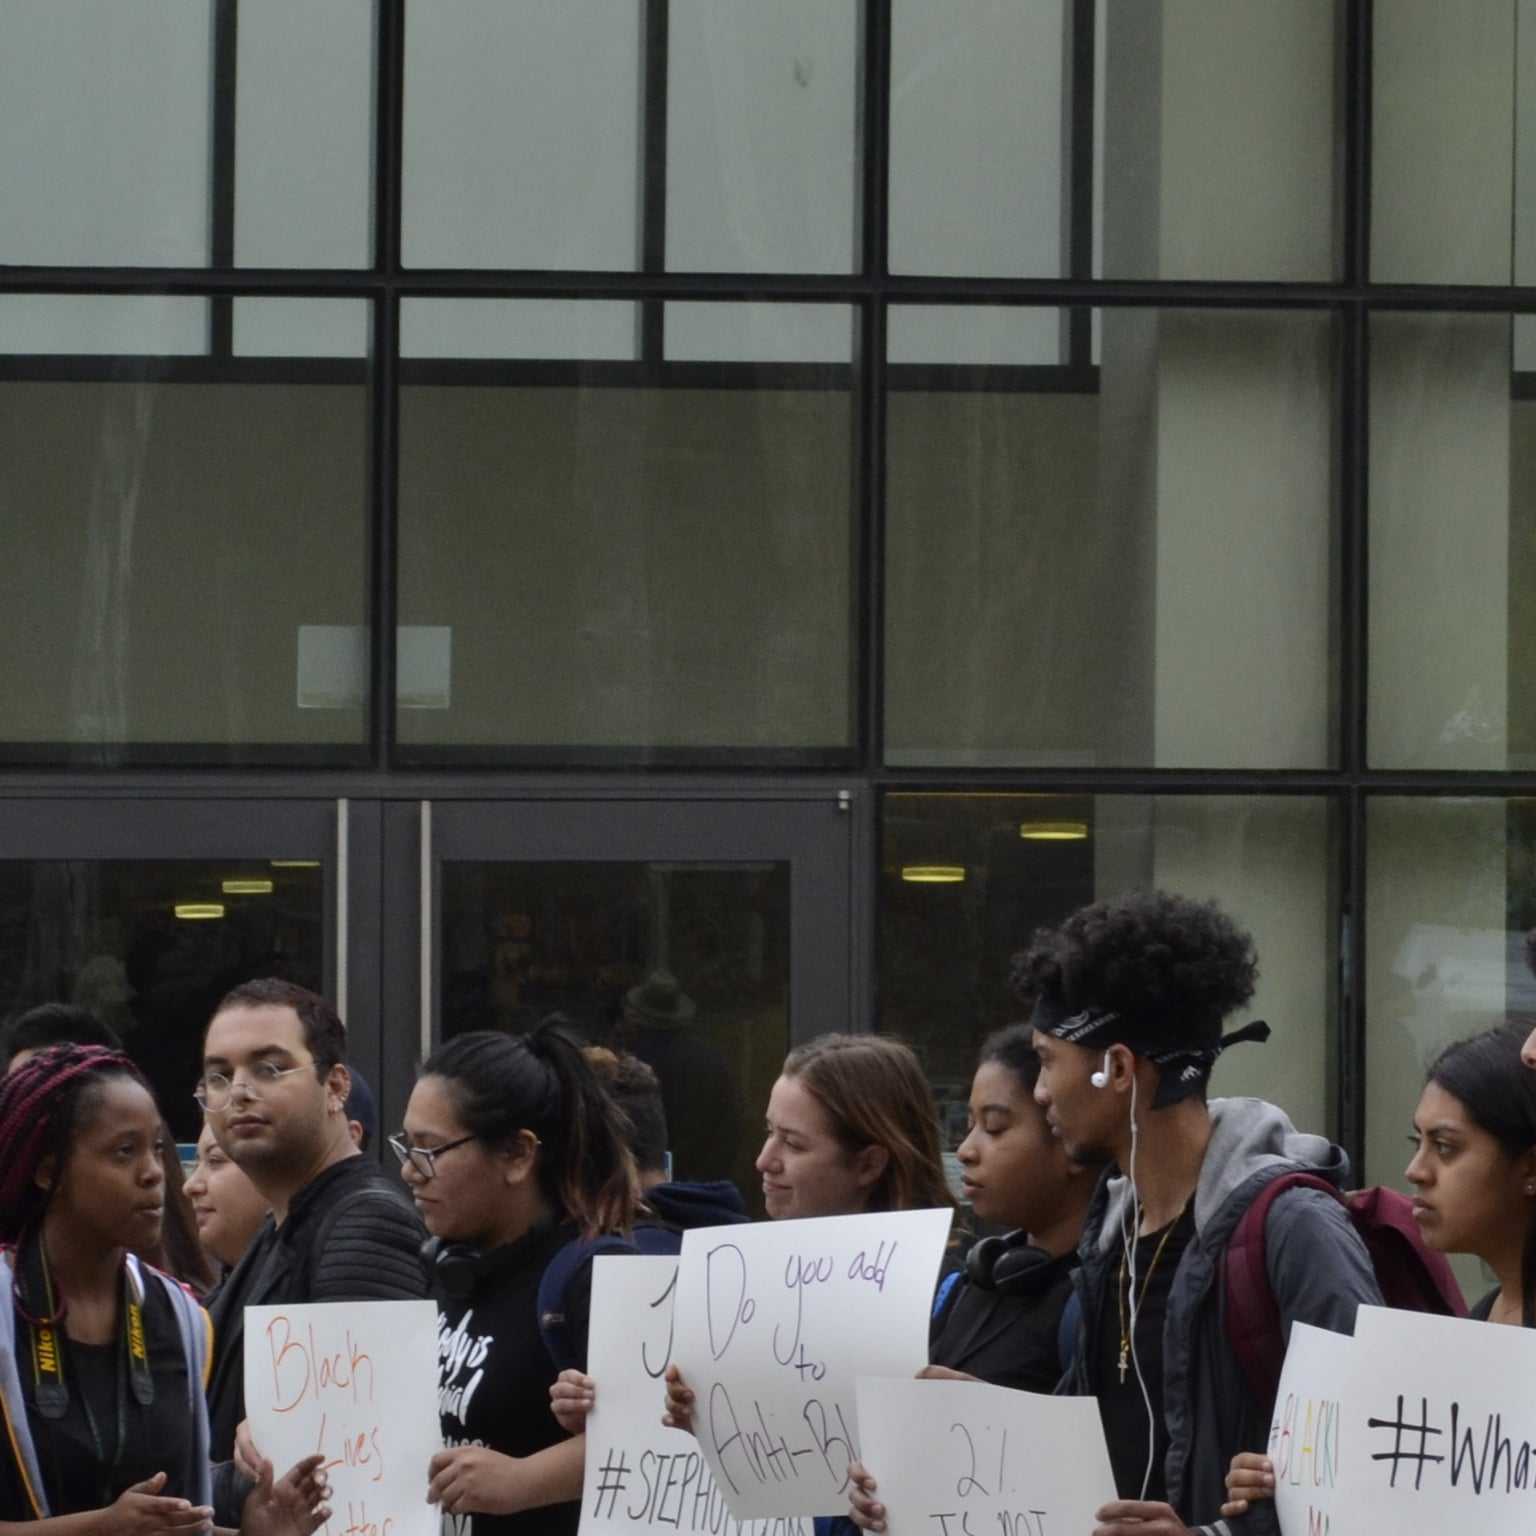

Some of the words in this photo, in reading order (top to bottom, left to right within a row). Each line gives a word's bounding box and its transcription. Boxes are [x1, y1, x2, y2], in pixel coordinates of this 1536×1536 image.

[128, 1303, 146, 1360] Nikon
[706, 1243, 754, 1360] Do
[773, 1252, 831, 1365] you
[846, 1240, 895, 1293] add
[794, 1343, 824, 1383] to
[708, 1382, 857, 1496] Anti-Bl
